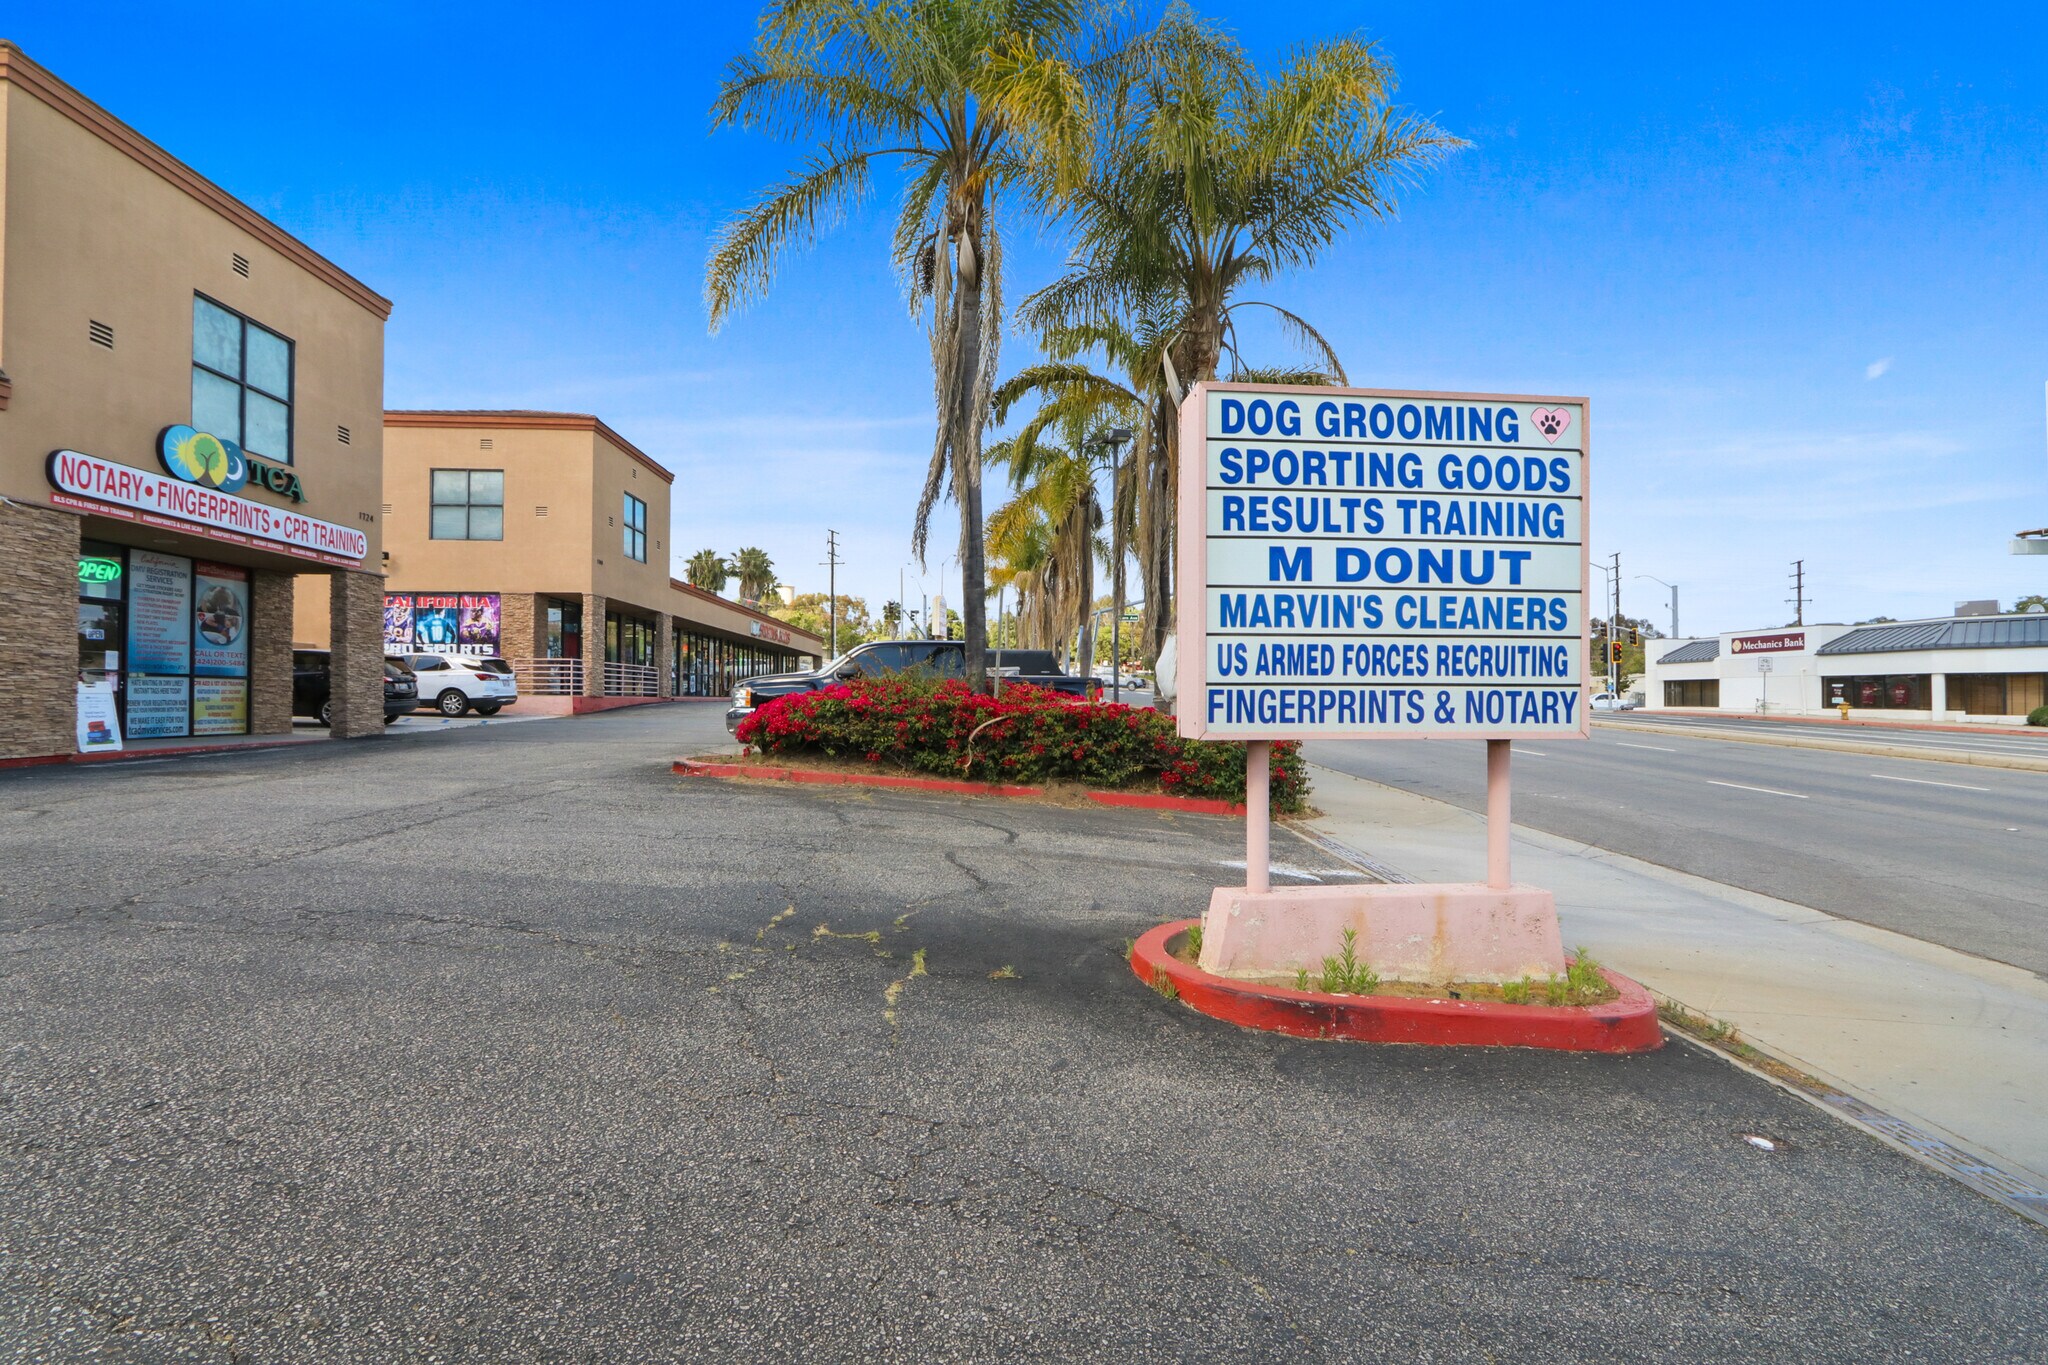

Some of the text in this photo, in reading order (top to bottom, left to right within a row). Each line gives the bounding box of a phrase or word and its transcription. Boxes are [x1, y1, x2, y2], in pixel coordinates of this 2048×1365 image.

[1221, 399, 1519, 442] DOG GROOMING
[248, 460, 308, 503] TCA
[1220, 448, 1571, 493] SPORTING GOODS
[60, 454, 364, 555] NOTARY FINGERPRINTS CPR TRAINING
[83, 502, 99, 511] FIRST
[99, 505, 109, 513] AID
[358, 512, 374, 523] 1724
[1222, 495, 1565, 538] RESULTS TRAINING
[79, 561, 116, 581] OPEN
[131, 565, 145, 573] DMV
[146, 567, 187, 579] REGISTRATION
[1268, 546, 1532, 585] M DONUT
[145, 575, 174, 585] SERVICES
[384, 595, 490, 609] CALIFORNIA
[1220, 594, 1568, 632] MARVIN'S CLEANERS
[423, 644, 494, 655] SPORTS
[1743, 637, 1804, 650] Mechanics Bank
[1217, 643, 1569, 678] US ARMED FORCES RECRUITING
[1208, 689, 1578, 724] FINGERPRINTS & NOTARY
[129, 725, 184, 736] tcadmvservices.com
